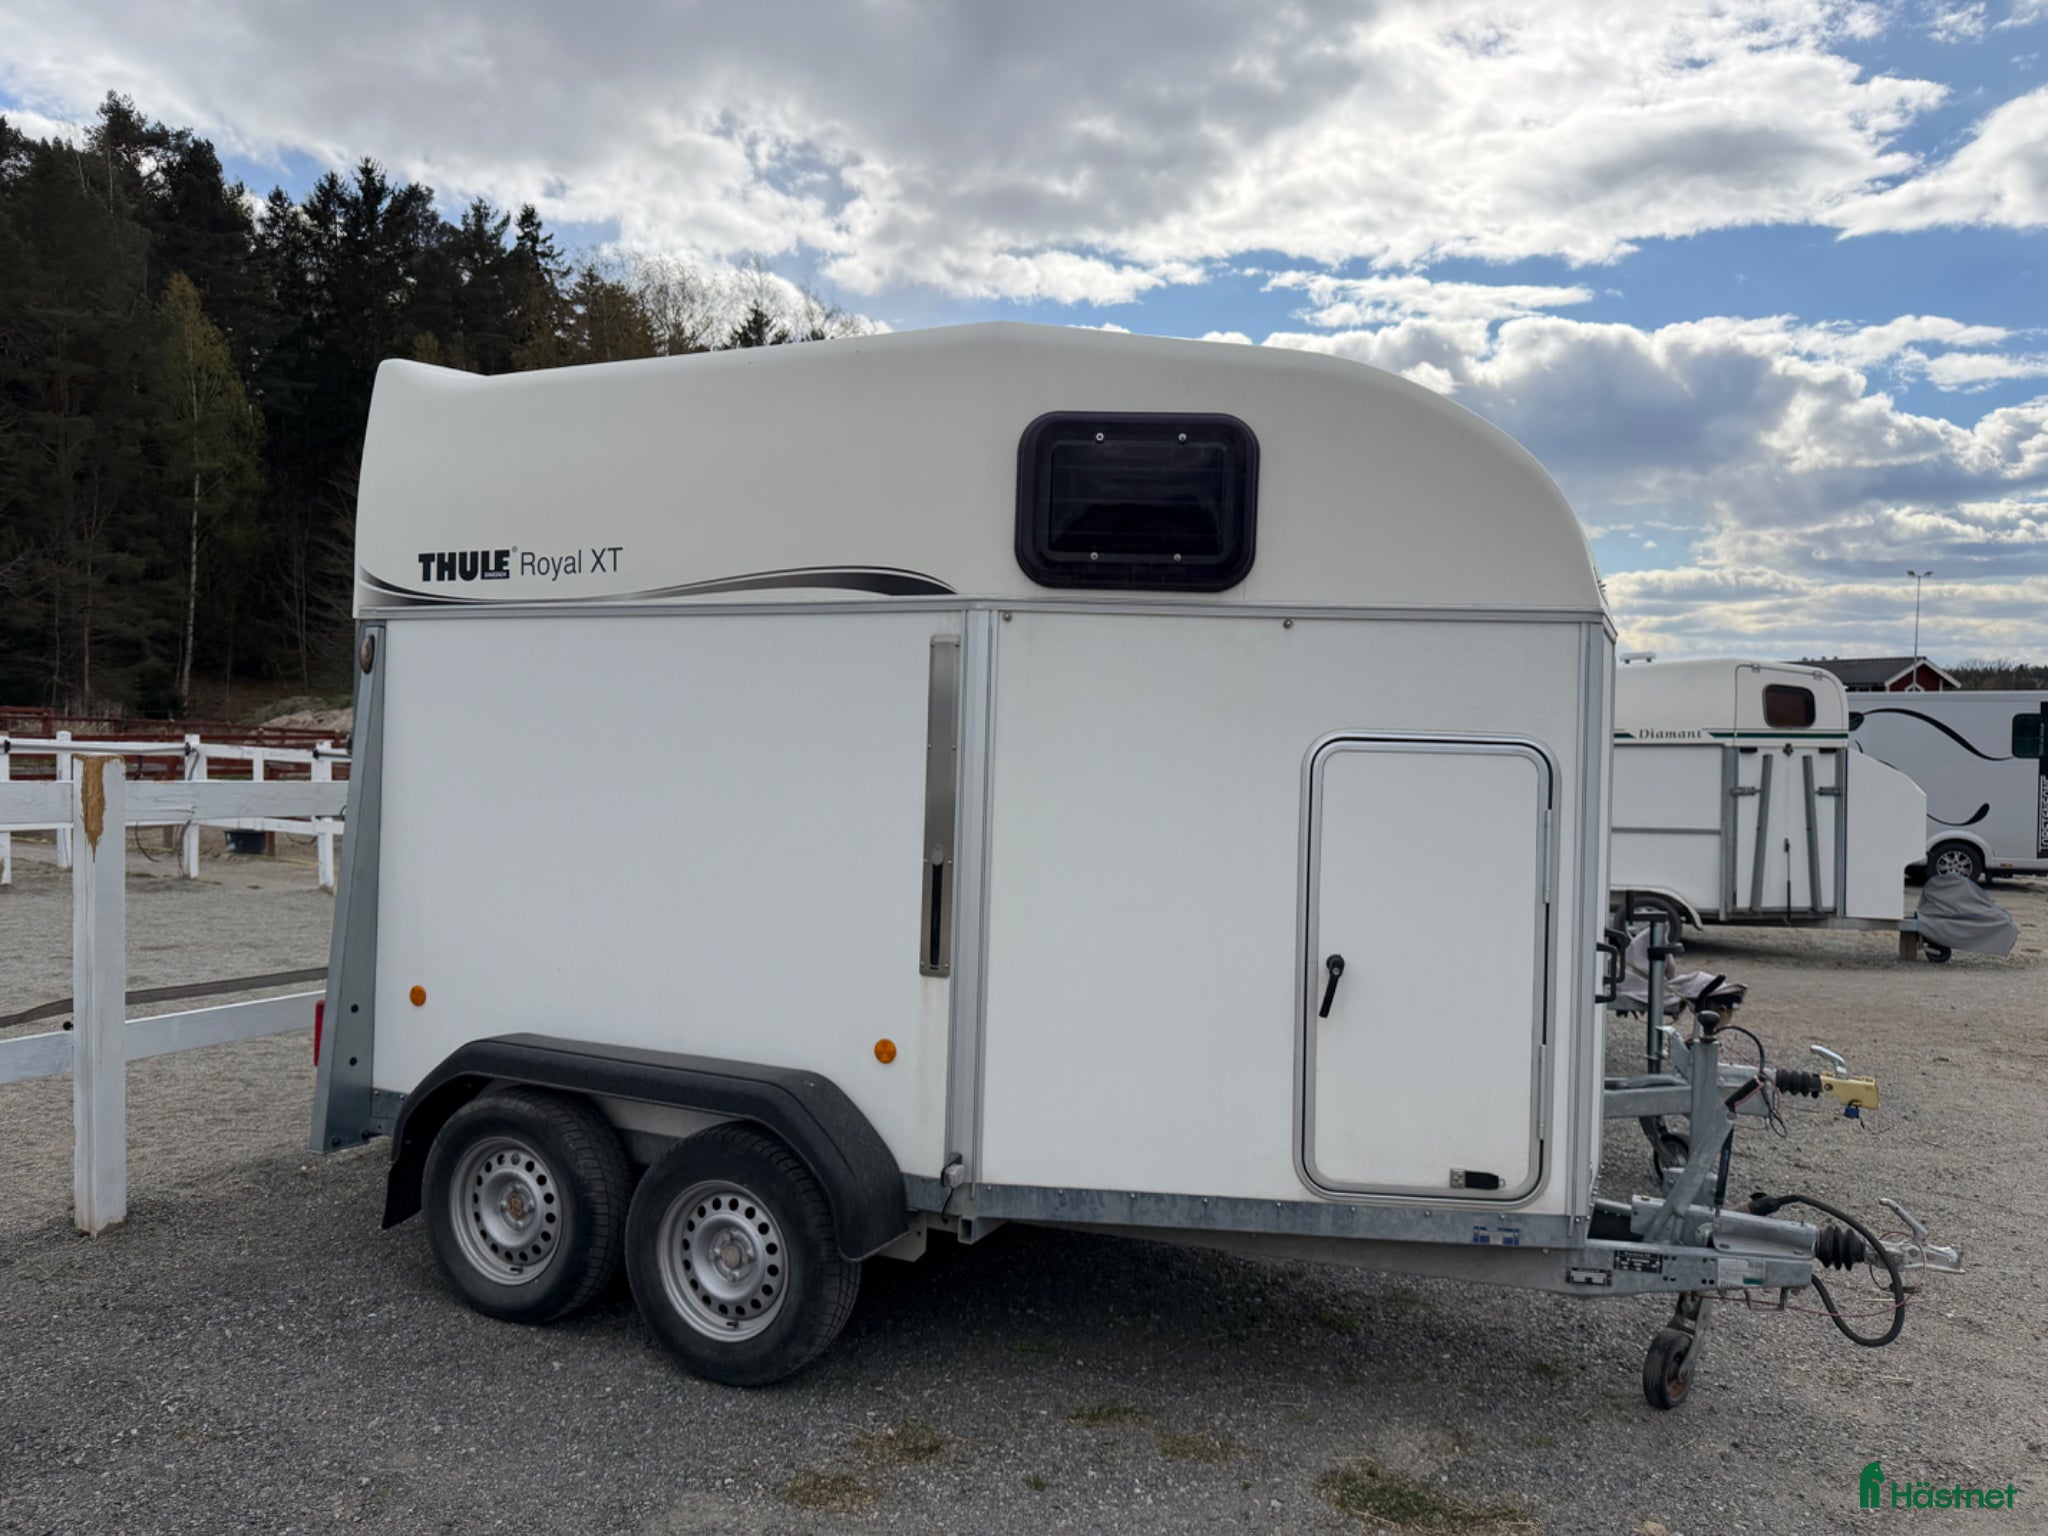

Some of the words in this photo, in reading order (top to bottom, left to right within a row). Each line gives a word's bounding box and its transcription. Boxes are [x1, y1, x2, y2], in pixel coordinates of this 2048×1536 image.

[418, 549, 510, 582] THULE
[521, 549, 582, 581] Royal
[590, 546, 623, 574] XT
[1639, 728, 1702, 739] Diamant
